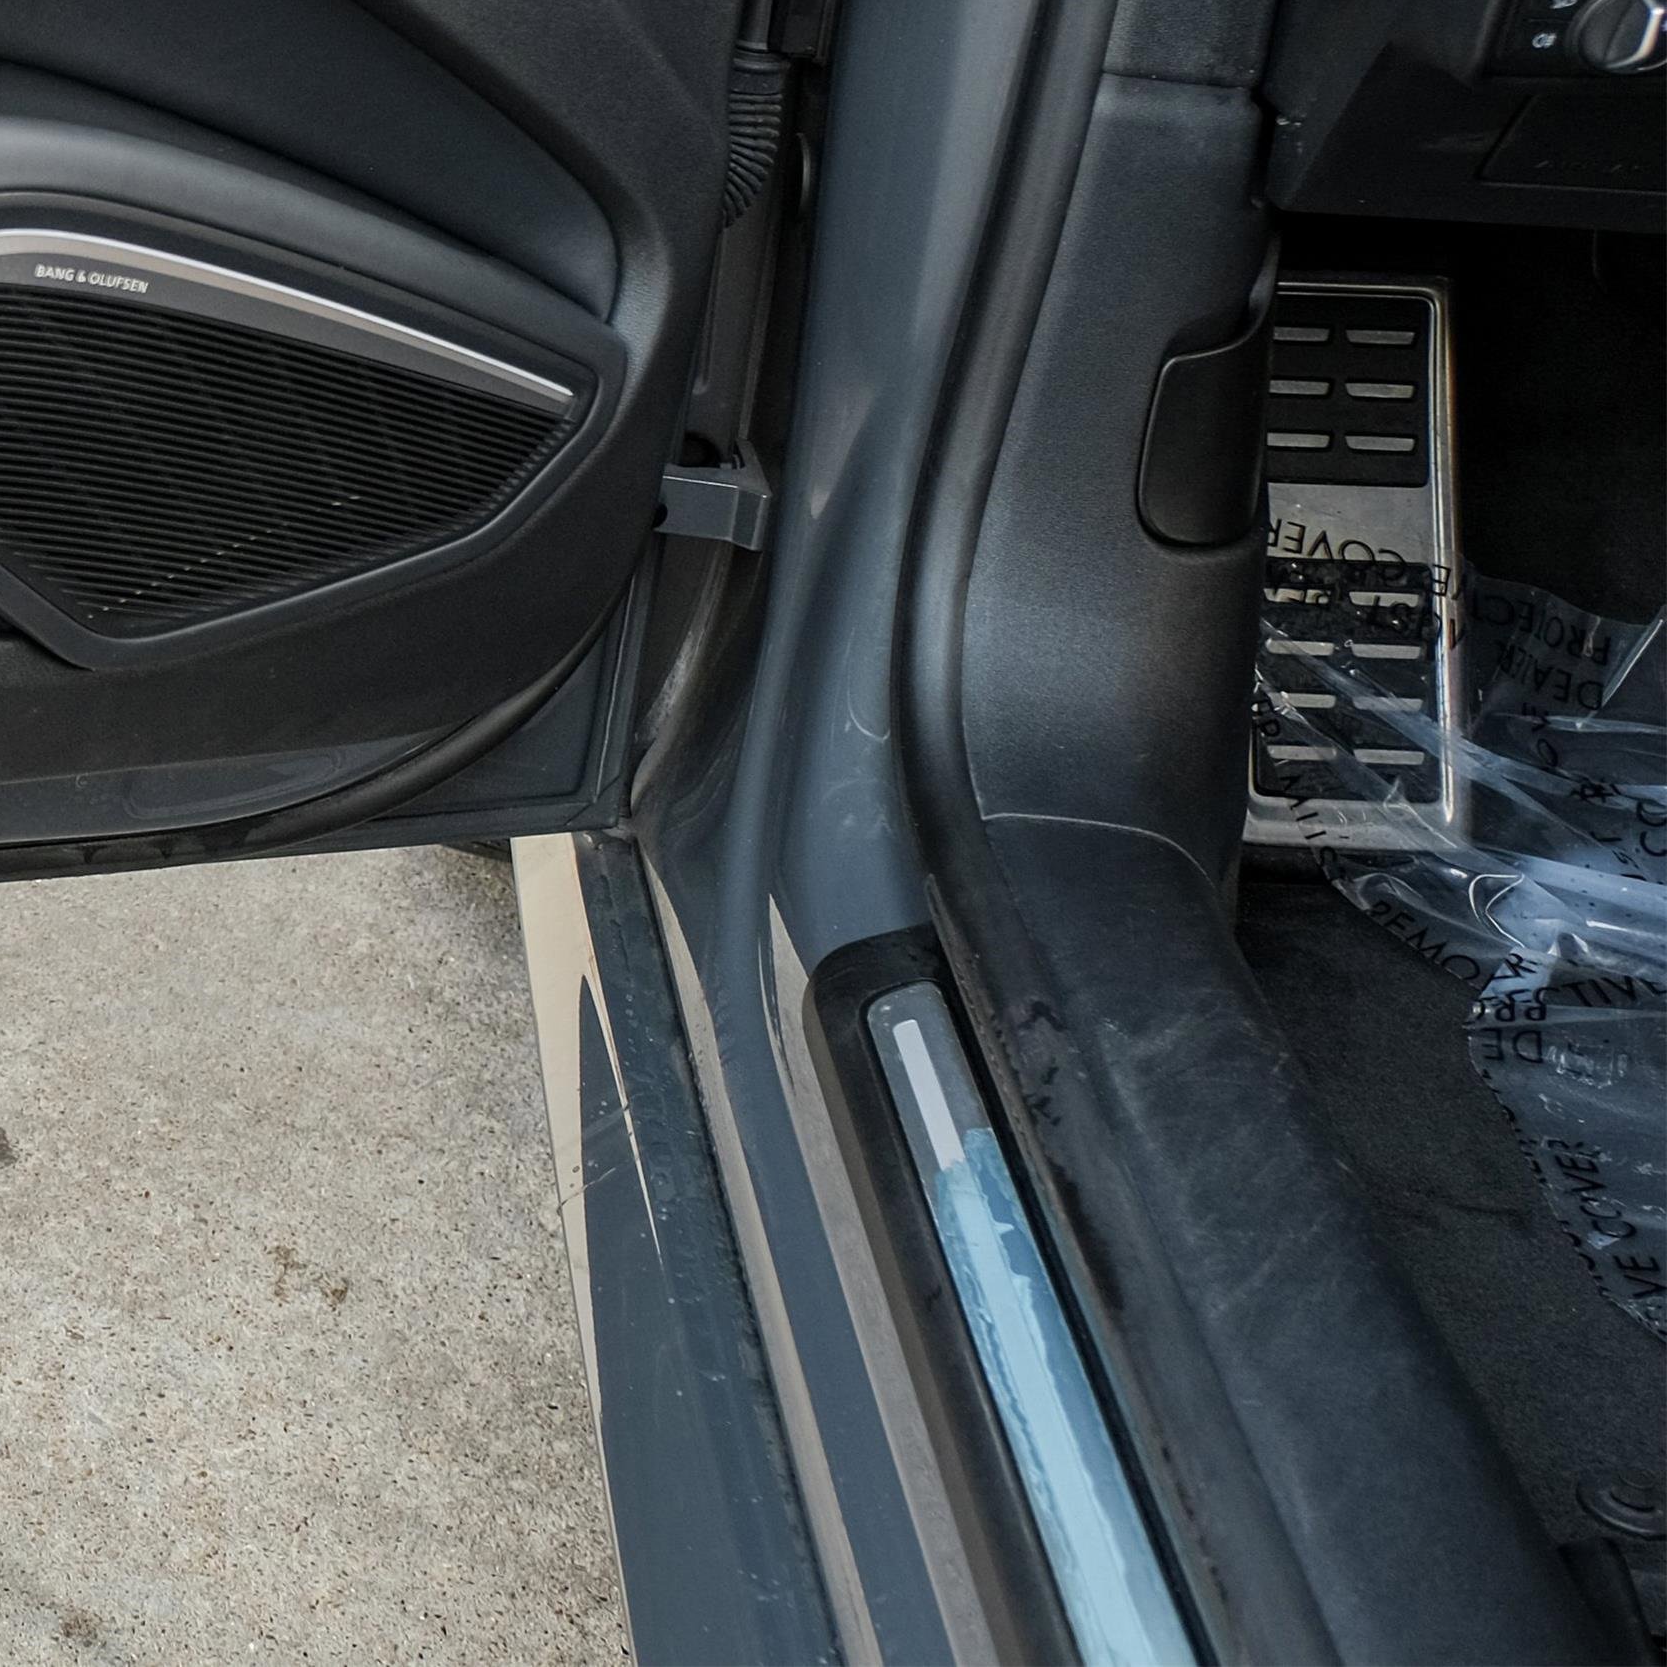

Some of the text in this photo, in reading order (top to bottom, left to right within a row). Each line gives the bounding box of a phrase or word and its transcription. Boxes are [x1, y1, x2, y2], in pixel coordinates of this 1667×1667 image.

[35, 264, 149, 294] BANG & OLUFSEN
